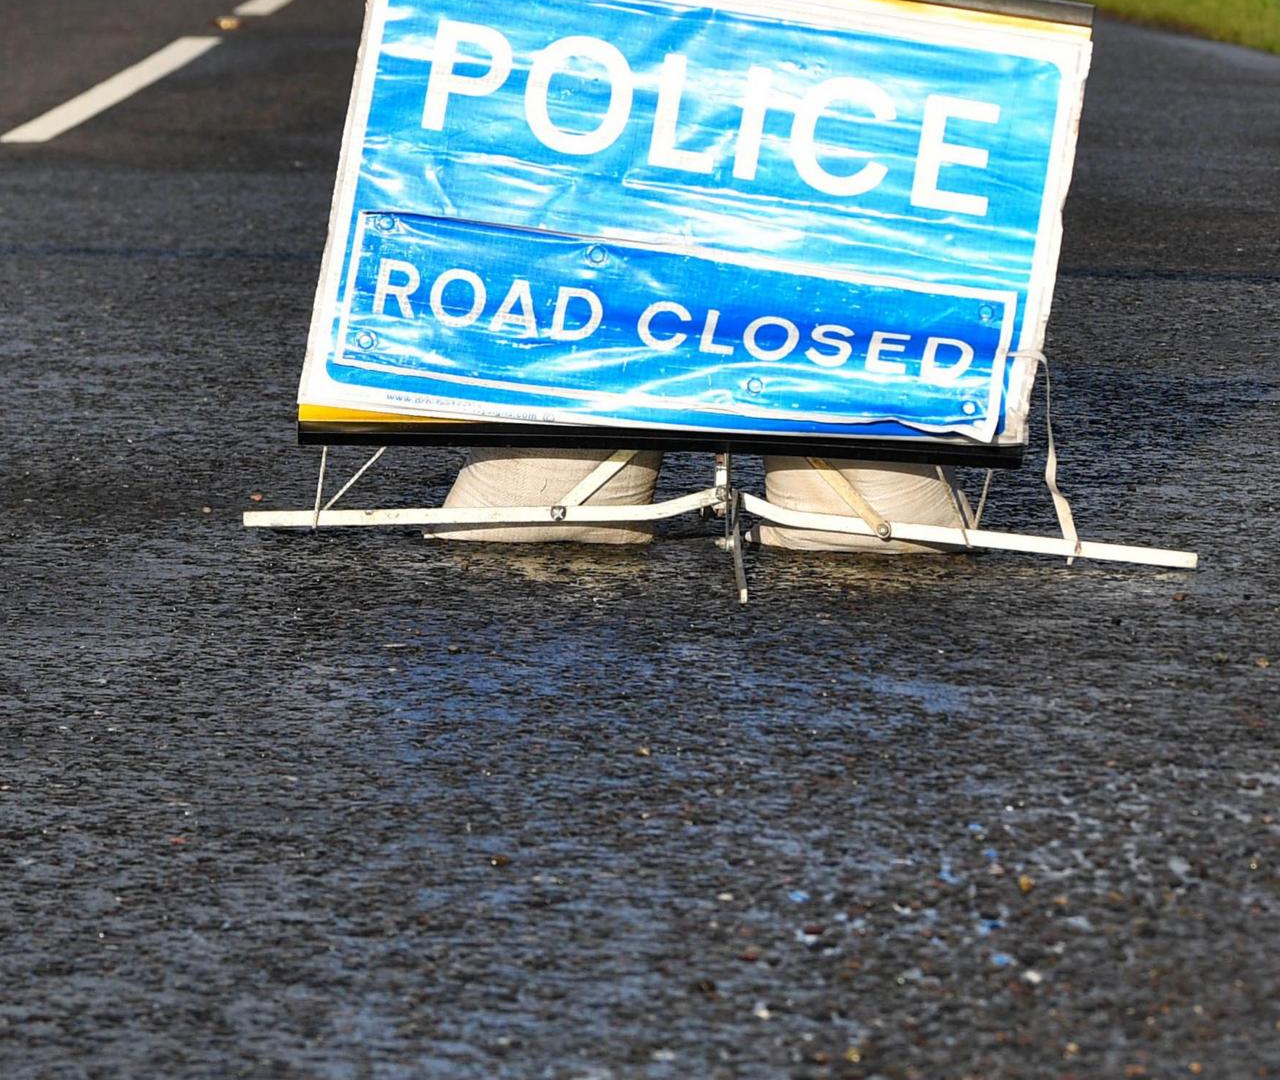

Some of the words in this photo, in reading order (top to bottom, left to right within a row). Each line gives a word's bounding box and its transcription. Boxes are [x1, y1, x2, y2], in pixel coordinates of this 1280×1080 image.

[421, 19, 1001, 216] POLICE
[371, 258, 603, 342] ROAD
[637, 300, 975, 383] CLOSED
